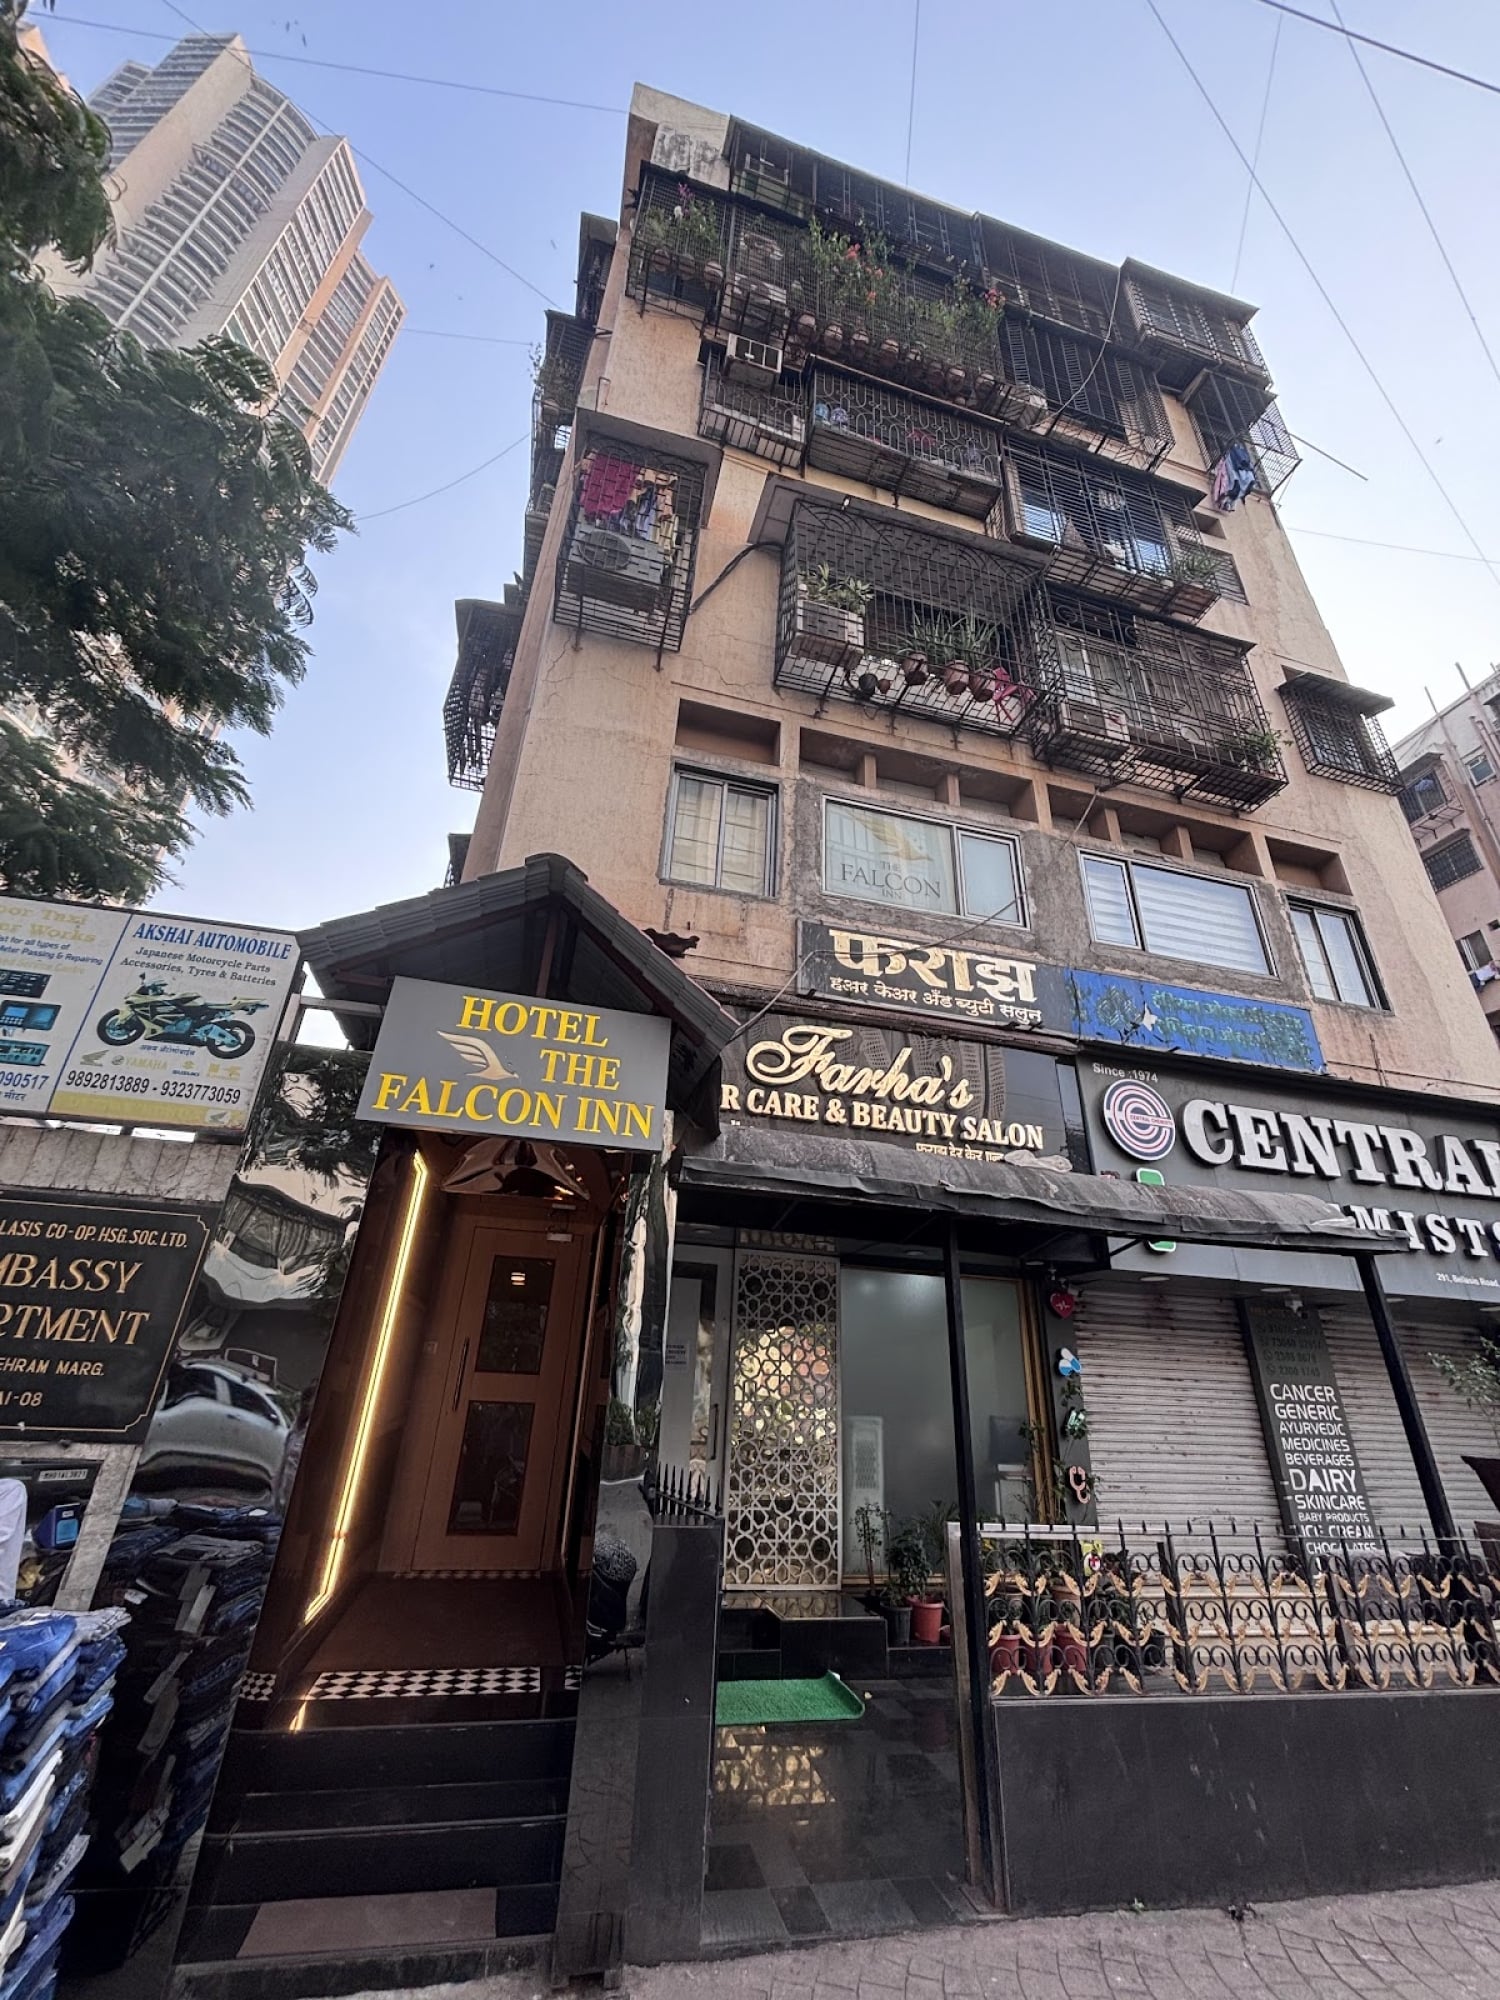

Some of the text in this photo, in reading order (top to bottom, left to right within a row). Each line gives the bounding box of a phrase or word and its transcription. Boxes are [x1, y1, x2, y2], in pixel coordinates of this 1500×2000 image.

[841, 863, 941, 898] FALCON
[30, 922, 96, 942] Works
[133, 922, 292, 960] AKSHAI AUTOMOBILE
[37, 940, 60, 950] types
[22, 948, 56, 959] Passing
[65, 953, 104, 966] Repairing
[136, 947, 271, 973] Japanese Motorcycle Parts
[829, 929, 1037, 1002] फराझ
[120, 958, 276, 986] Accessories, Tyres & Batteries
[874, 980, 917, 1004] केअर
[456, 995, 609, 1048] HOTEL
[125, 1057, 168, 1071] YAMAHA
[539, 1049, 621, 1091] THE
[745, 1025, 976, 1110] Farha's
[1093, 1062, 1125, 1077] Since
[66, 1070, 150, 1093] 9892813889
[160, 1080, 240, 1104] 9323773059
[371, 1072, 655, 1140] FALCON INN
[747, 1087, 819, 1122] CARE
[825, 1099, 847, 1125] &
[852, 1102, 958, 1137] BEAUTY
[961, 1118, 1044, 1150] SALON
[159, 1231, 188, 1248] LTD.
[1327, 1203, 1500, 1257] MIST
[56, 1360, 105, 1377] MARG.
[1269, 1384, 1337, 1402] CANCER
[1274, 1403, 1342, 1421] GENERIC
[1279, 1422, 1346, 1436] AYURVEDIC
[1281, 1437, 1350, 1452] MEDICINES
[1284, 1452, 1354, 1467] BEVERAGES
[1289, 1468, 1357, 1493] DAIRY
[1294, 1494, 1367, 1511] SKINCARE
[1298, 1512, 1369, 1522] BABY PRODUCTS
[1328, 1524, 1375, 1538] CREAM
[1305, 1541, 1377, 1554] CHOCLATES
